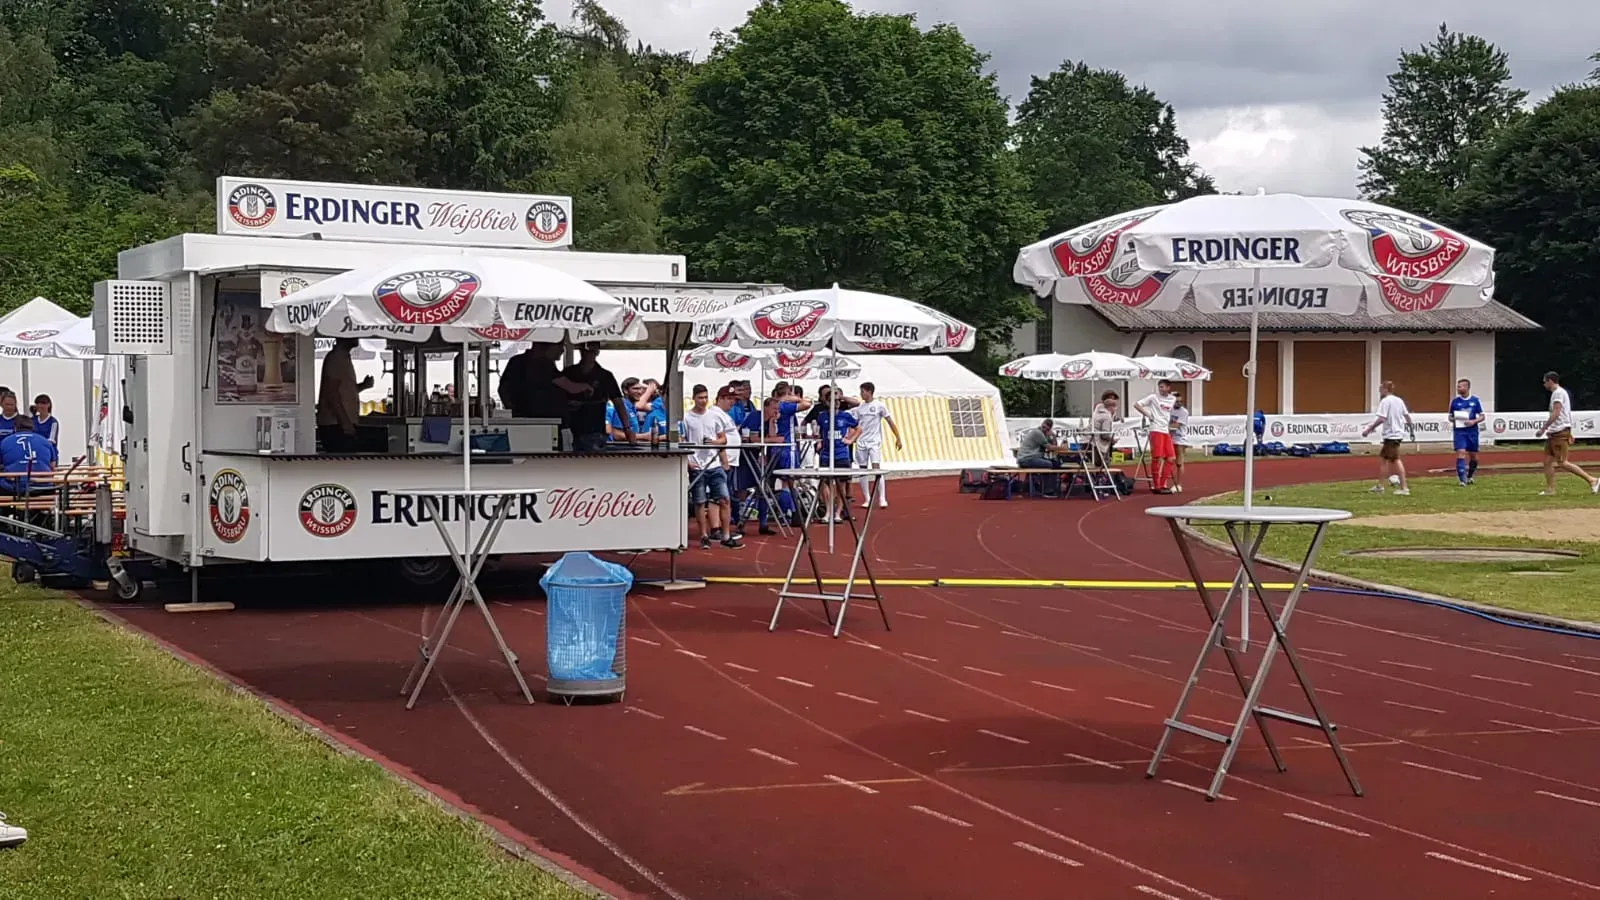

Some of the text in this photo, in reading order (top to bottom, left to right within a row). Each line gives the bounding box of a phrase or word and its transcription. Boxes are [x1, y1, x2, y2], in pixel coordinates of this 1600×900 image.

[231, 186, 273, 206] ERDINGER
[285, 193, 519, 235] ERDINGER Weißbier
[528, 203, 565, 220] ERDINGER
[1172, 237, 1300, 265] ERDINGER
[514, 303, 593, 325] ERDINGER
[853, 322, 919, 341] ERDINGER
[1287, 423, 1329, 435] ERDINGER
[211, 473, 247, 502] ERDINGER
[302, 487, 353, 508] ERDINGER
[371, 487, 657, 527] ERDINGER Weißbier
